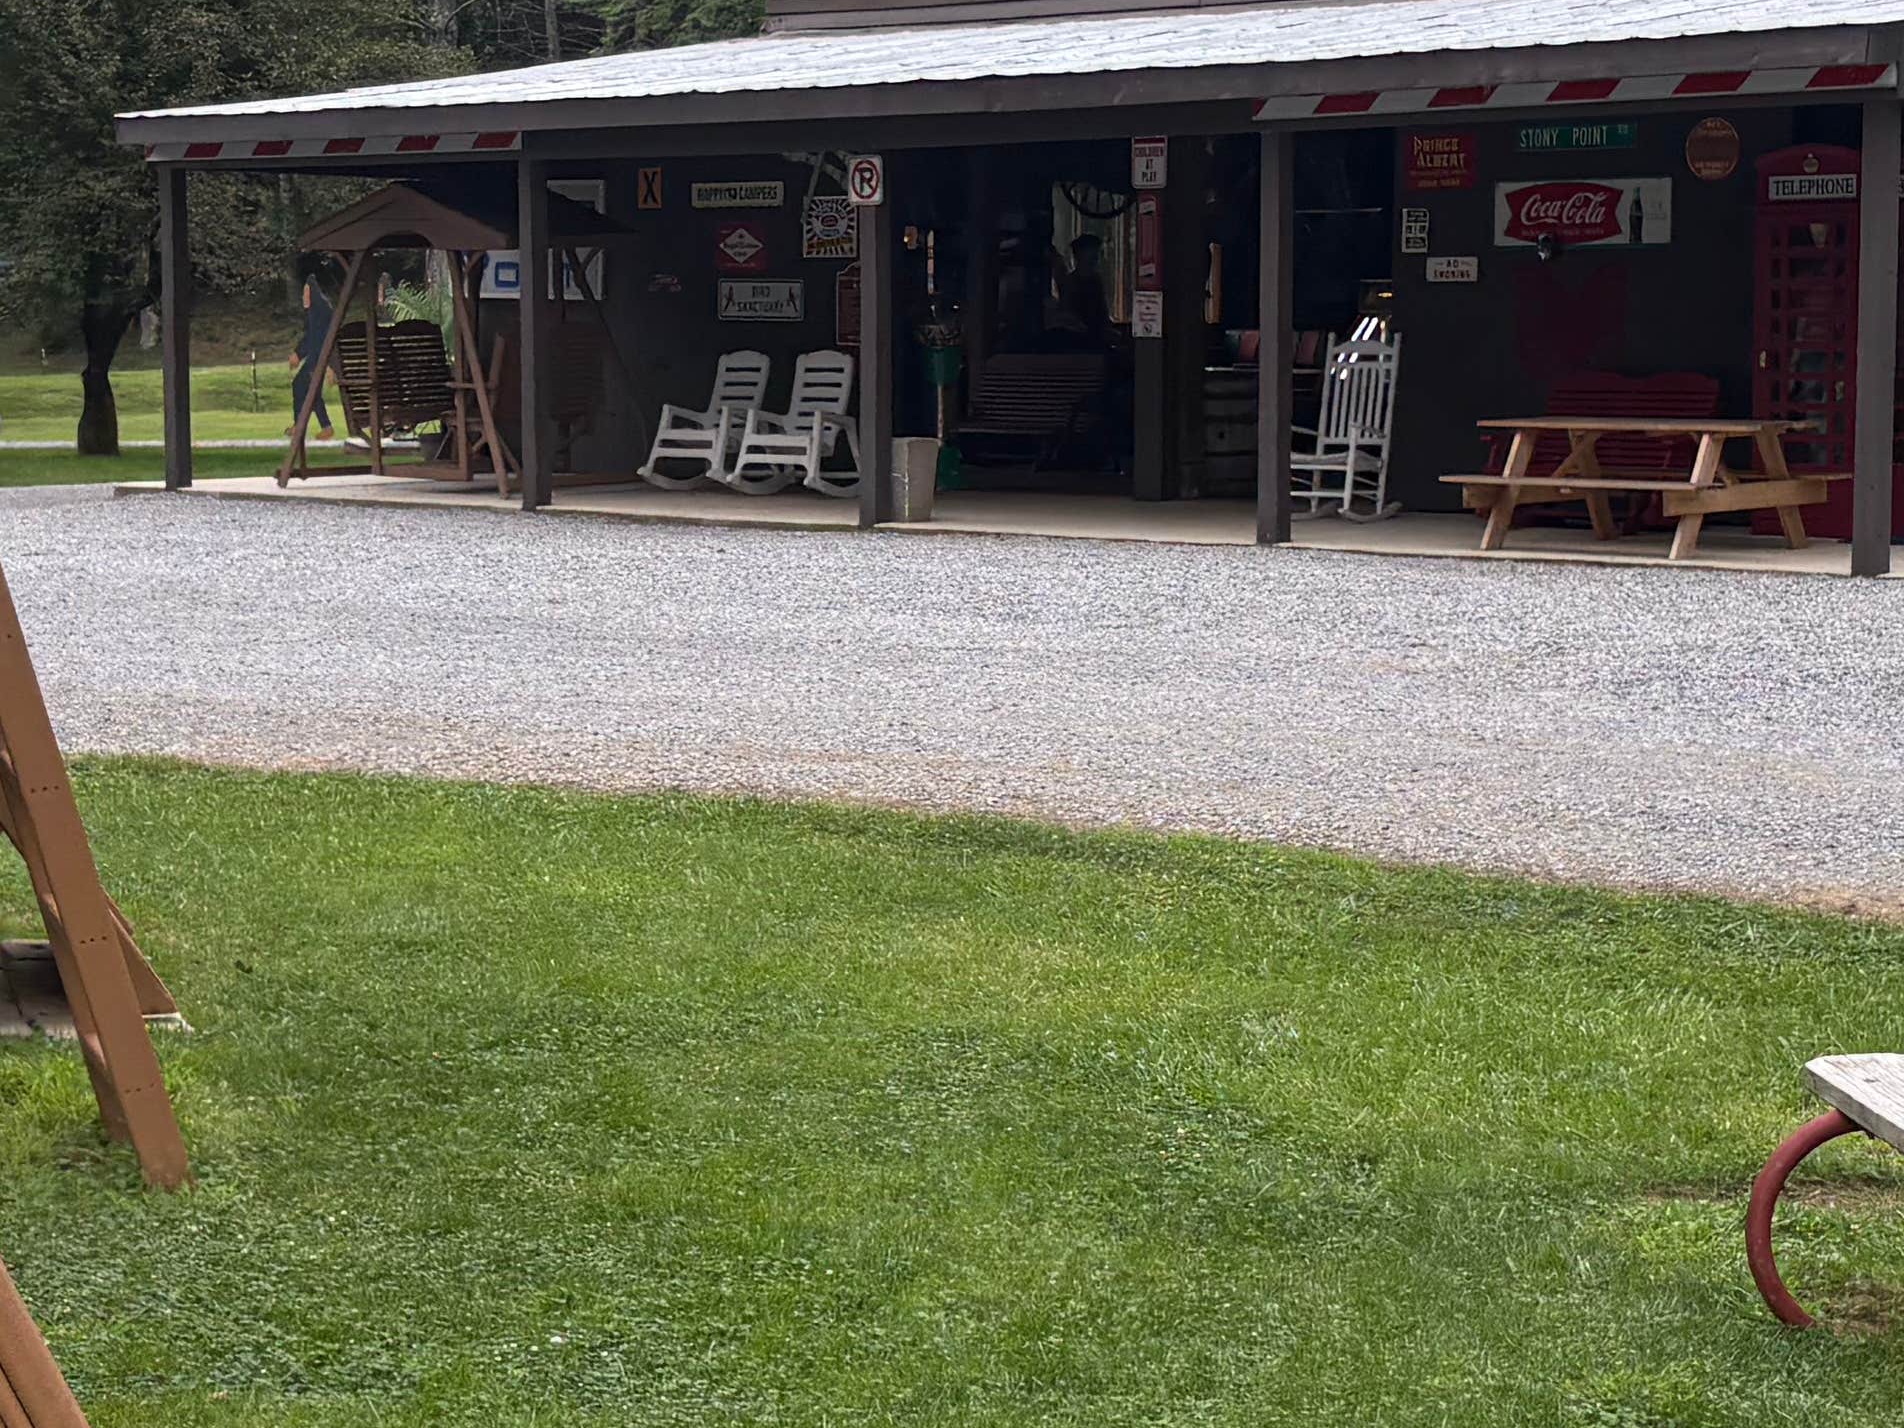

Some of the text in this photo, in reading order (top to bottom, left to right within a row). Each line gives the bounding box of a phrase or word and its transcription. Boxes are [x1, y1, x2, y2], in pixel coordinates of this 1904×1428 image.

[1519, 127, 1559, 148] STONY
[1571, 125, 1609, 147] POINT
[1773, 177, 1855, 197] TELEPHONE
[1521, 191, 1611, 226] Coca-Cola
